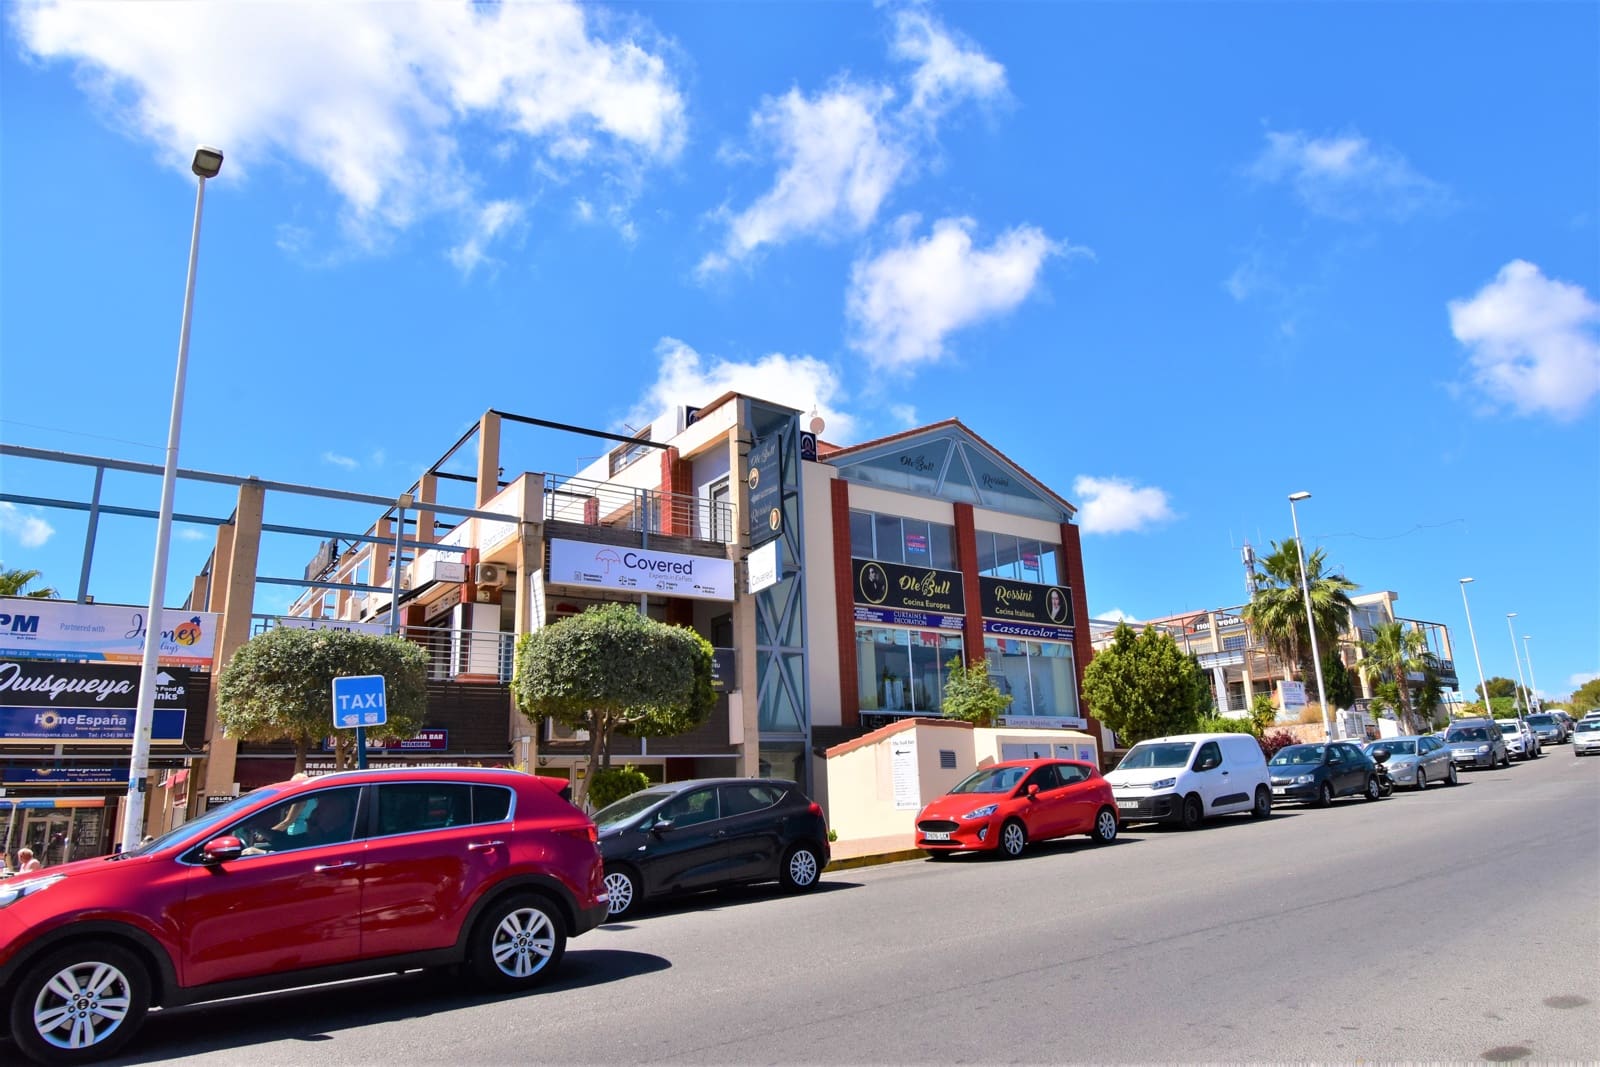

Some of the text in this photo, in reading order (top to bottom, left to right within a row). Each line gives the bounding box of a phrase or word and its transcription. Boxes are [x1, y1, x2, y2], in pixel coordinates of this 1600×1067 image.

[915, 455, 935, 472] Bull
[623, 552, 693, 575] Covered
[649, 572, 669, 580] Experts
[899, 575, 921, 592] Ole
[994, 585, 1034, 606] Rossini
[903, 597, 951, 610] Cocina Europea
[893, 611, 922, 620] CURTAINS
[995, 607, 1035, 618] Cocina Italiana
[894, 617, 927, 626] DECORATION
[991, 623, 1057, 638] Cassacolor
[154, 691, 178, 701] inks
[176, 686, 185, 695] &
[338, 692, 383, 710] TAXI
[34, 712, 127, 728] HomeEspaña
